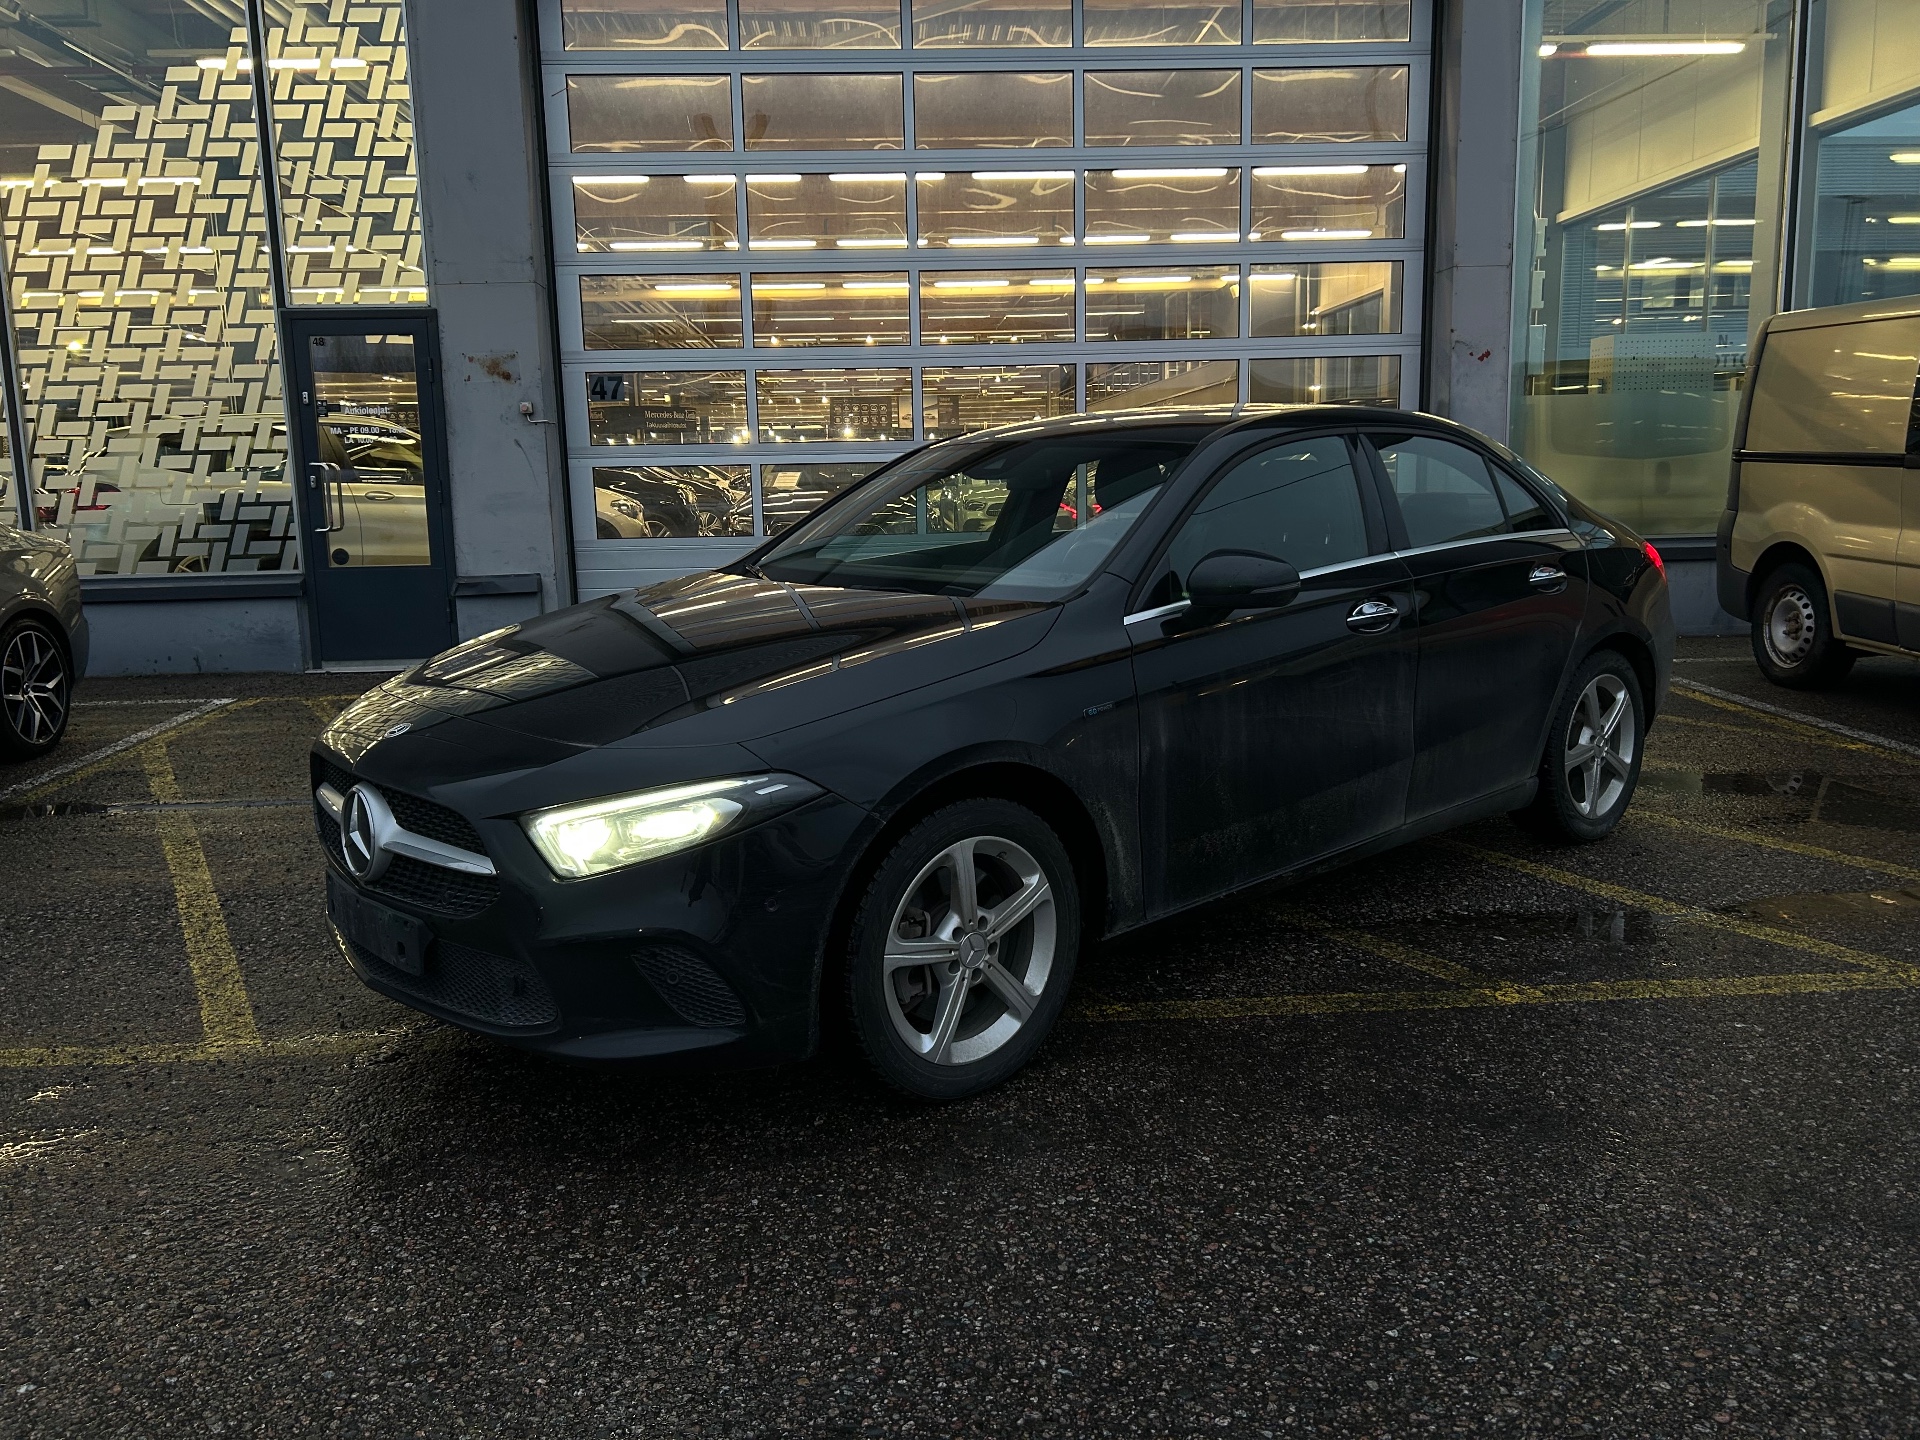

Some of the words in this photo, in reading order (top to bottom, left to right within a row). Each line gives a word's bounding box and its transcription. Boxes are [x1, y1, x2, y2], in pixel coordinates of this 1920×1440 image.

[312, 337, 325, 346] 48
[591, 376, 623, 400] 47
[644, 410, 685, 419] Mercedes-Benz
